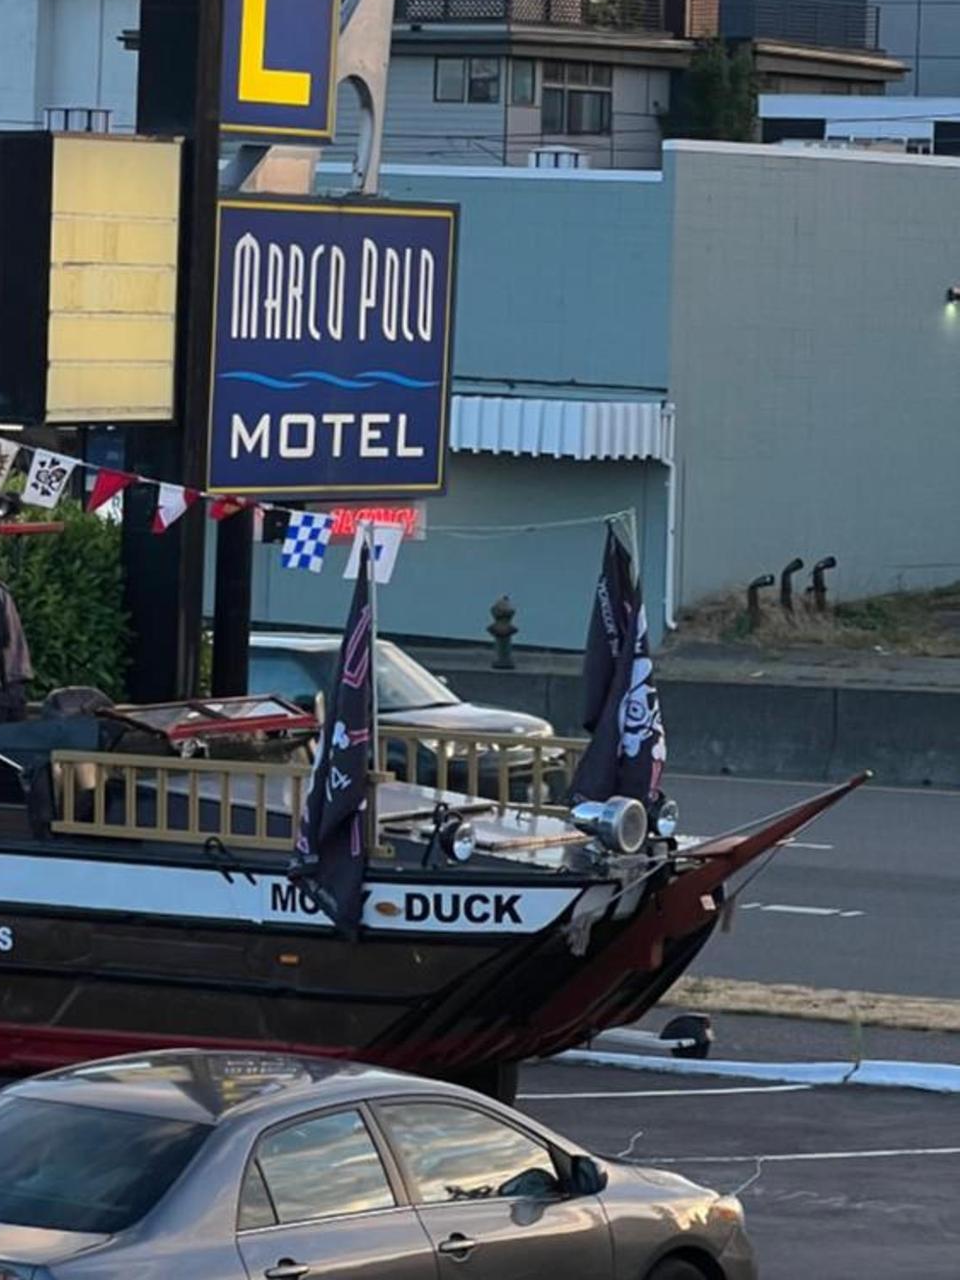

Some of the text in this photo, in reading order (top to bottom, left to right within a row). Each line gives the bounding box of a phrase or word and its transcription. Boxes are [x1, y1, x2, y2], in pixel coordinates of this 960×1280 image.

[231, 233, 434, 341] MARCO POLO
[231, 413, 424, 459] MOTEL
[404, 892, 523, 924] DUCK
